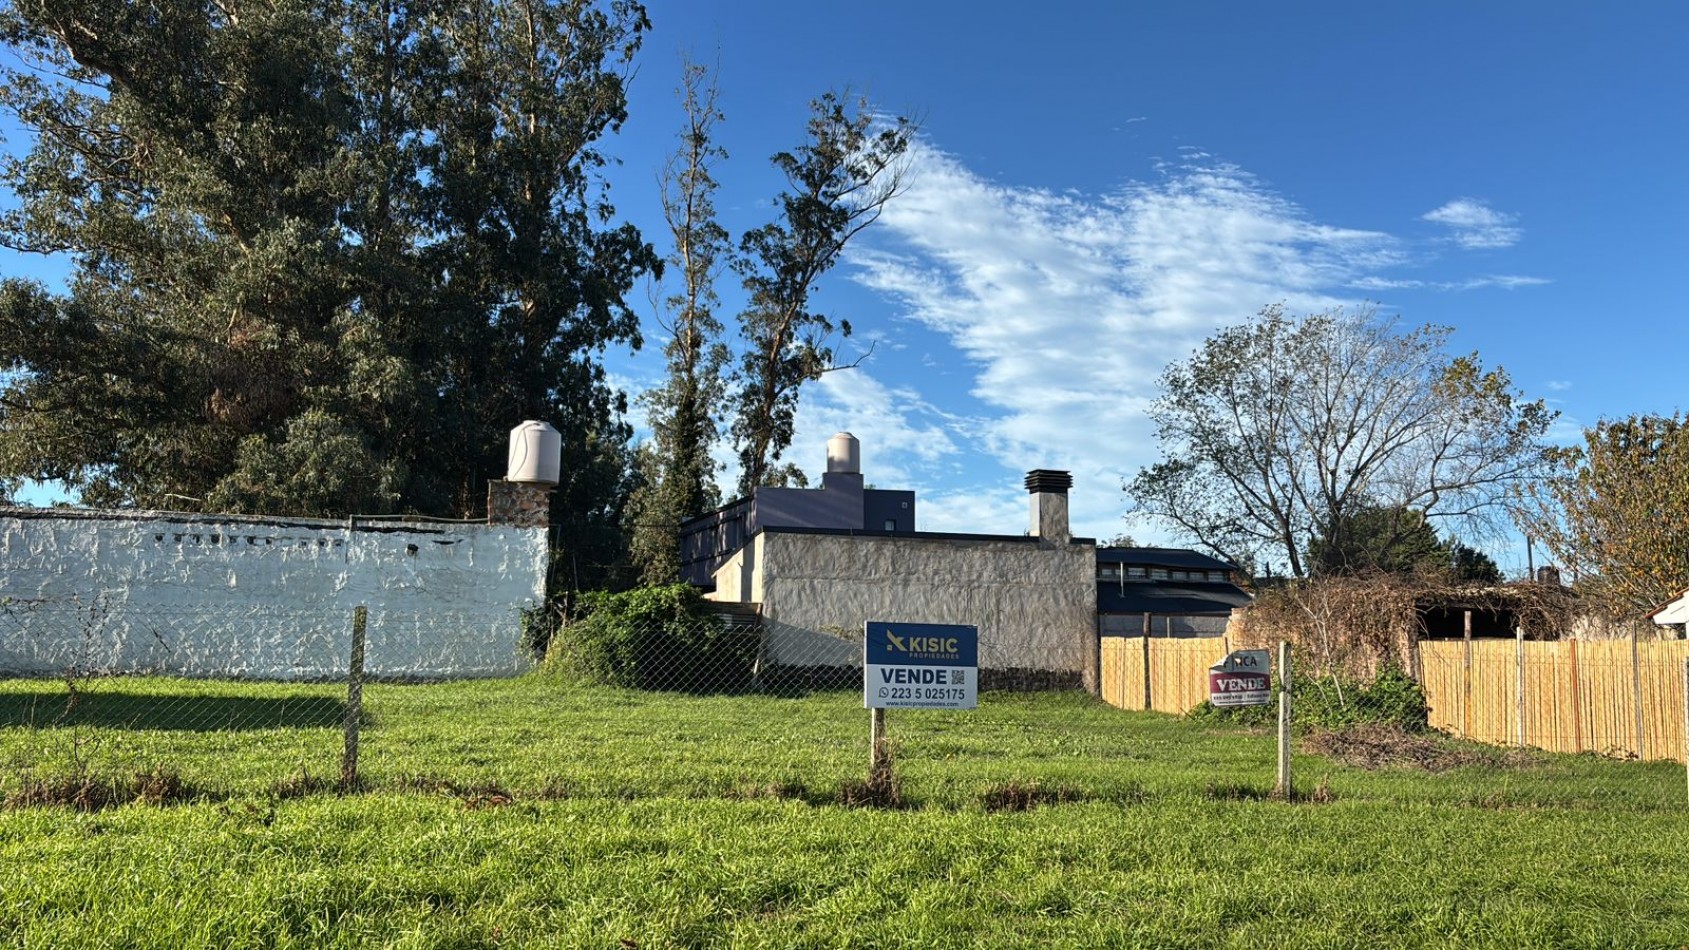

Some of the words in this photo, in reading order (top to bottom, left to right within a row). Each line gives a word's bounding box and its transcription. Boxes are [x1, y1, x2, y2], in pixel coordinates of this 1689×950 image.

[909, 637, 958, 653] KISIC
[880, 668, 947, 685] VENDE
[1216, 677, 1266, 692] VENDE
[891, 687, 912, 699] 223
[915, 688, 922, 699] 5
[925, 689, 965, 700] 025175
